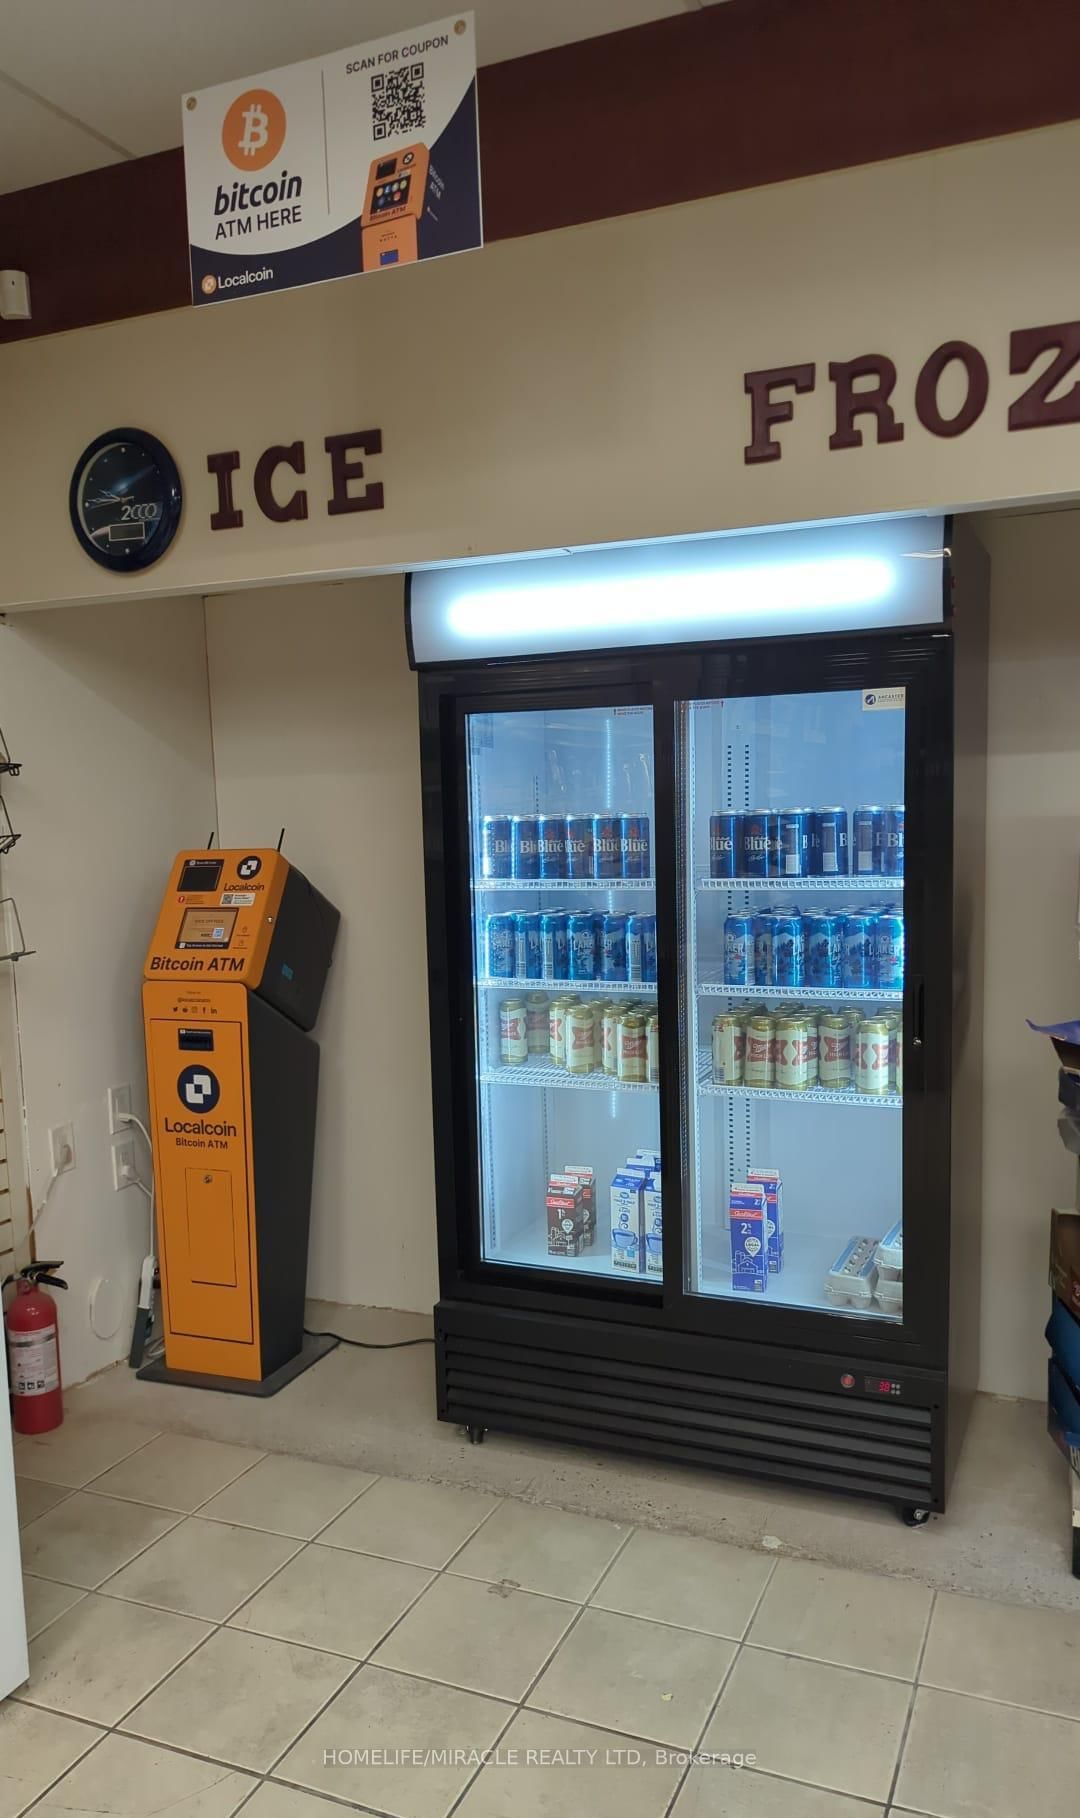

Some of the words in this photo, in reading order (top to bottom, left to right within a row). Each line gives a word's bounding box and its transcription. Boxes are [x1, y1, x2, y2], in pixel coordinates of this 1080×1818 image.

[346, 57, 376, 75] SCAN
[377, 46, 399, 65] FOR
[401, 35, 449, 58] COUPON
[214, 170, 302, 216] bitcoin
[215, 216, 252, 240] ATM
[257, 205, 302, 231] HERE
[218, 267, 274, 289] Localcoin
[744, 320, 1080, 465] FROZ
[207, 428, 385, 531] ICE
[538, 839, 563, 853] Blue
[621, 838, 648, 852] Blue
[223, 882, 264, 892] Localcoin
[150, 957, 204, 971] Bitcoin
[208, 957, 245, 972] ATM
[165, 1117, 237, 1137] Localcoin
[176, 1138, 206, 1149] Bitcoin
[208, 1139, 228, 1150] ATM
